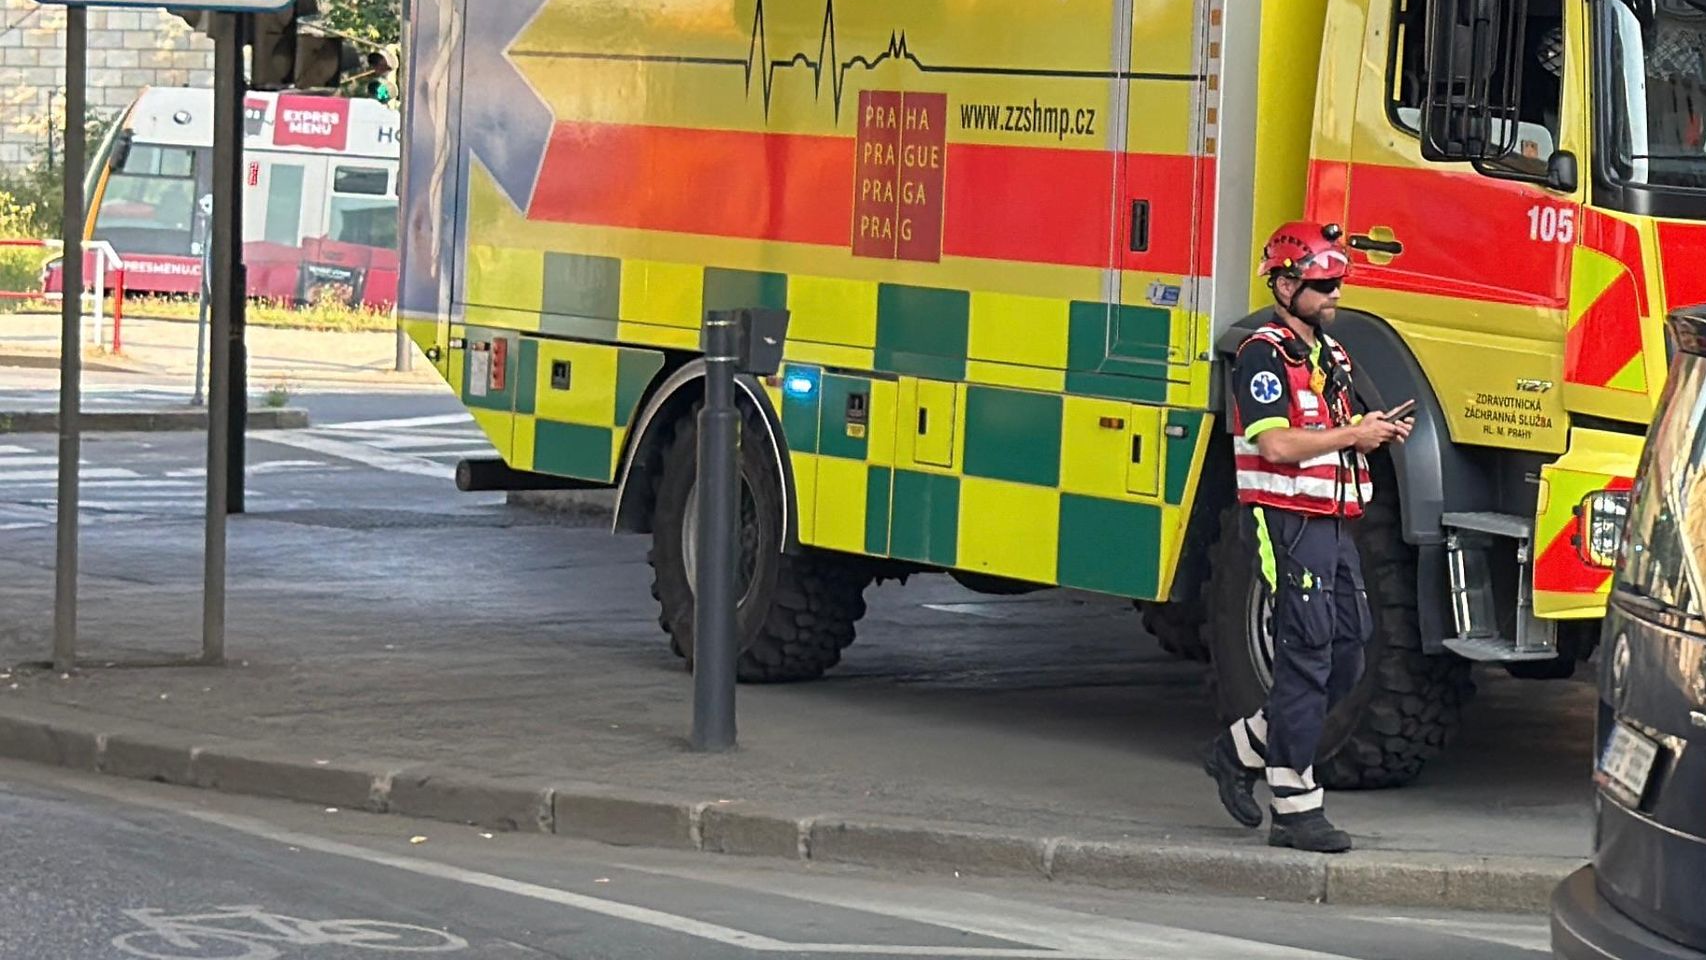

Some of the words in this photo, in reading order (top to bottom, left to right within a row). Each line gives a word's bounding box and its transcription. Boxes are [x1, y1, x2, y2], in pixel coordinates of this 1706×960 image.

[283, 109, 340, 125] EXPRES
[960, 97, 1095, 141] www.zzshmp.cz
[288, 122, 332, 136] MENU
[1527, 205, 1574, 245] 105
[1475, 393, 1542, 412] ZDRAVOTNICKÁ
[1464, 405, 1517, 425] ZÁCHRANNÁ
[1519, 414, 1552, 429] SLUŽBA
[1507, 427, 1532, 440] PRAHY
